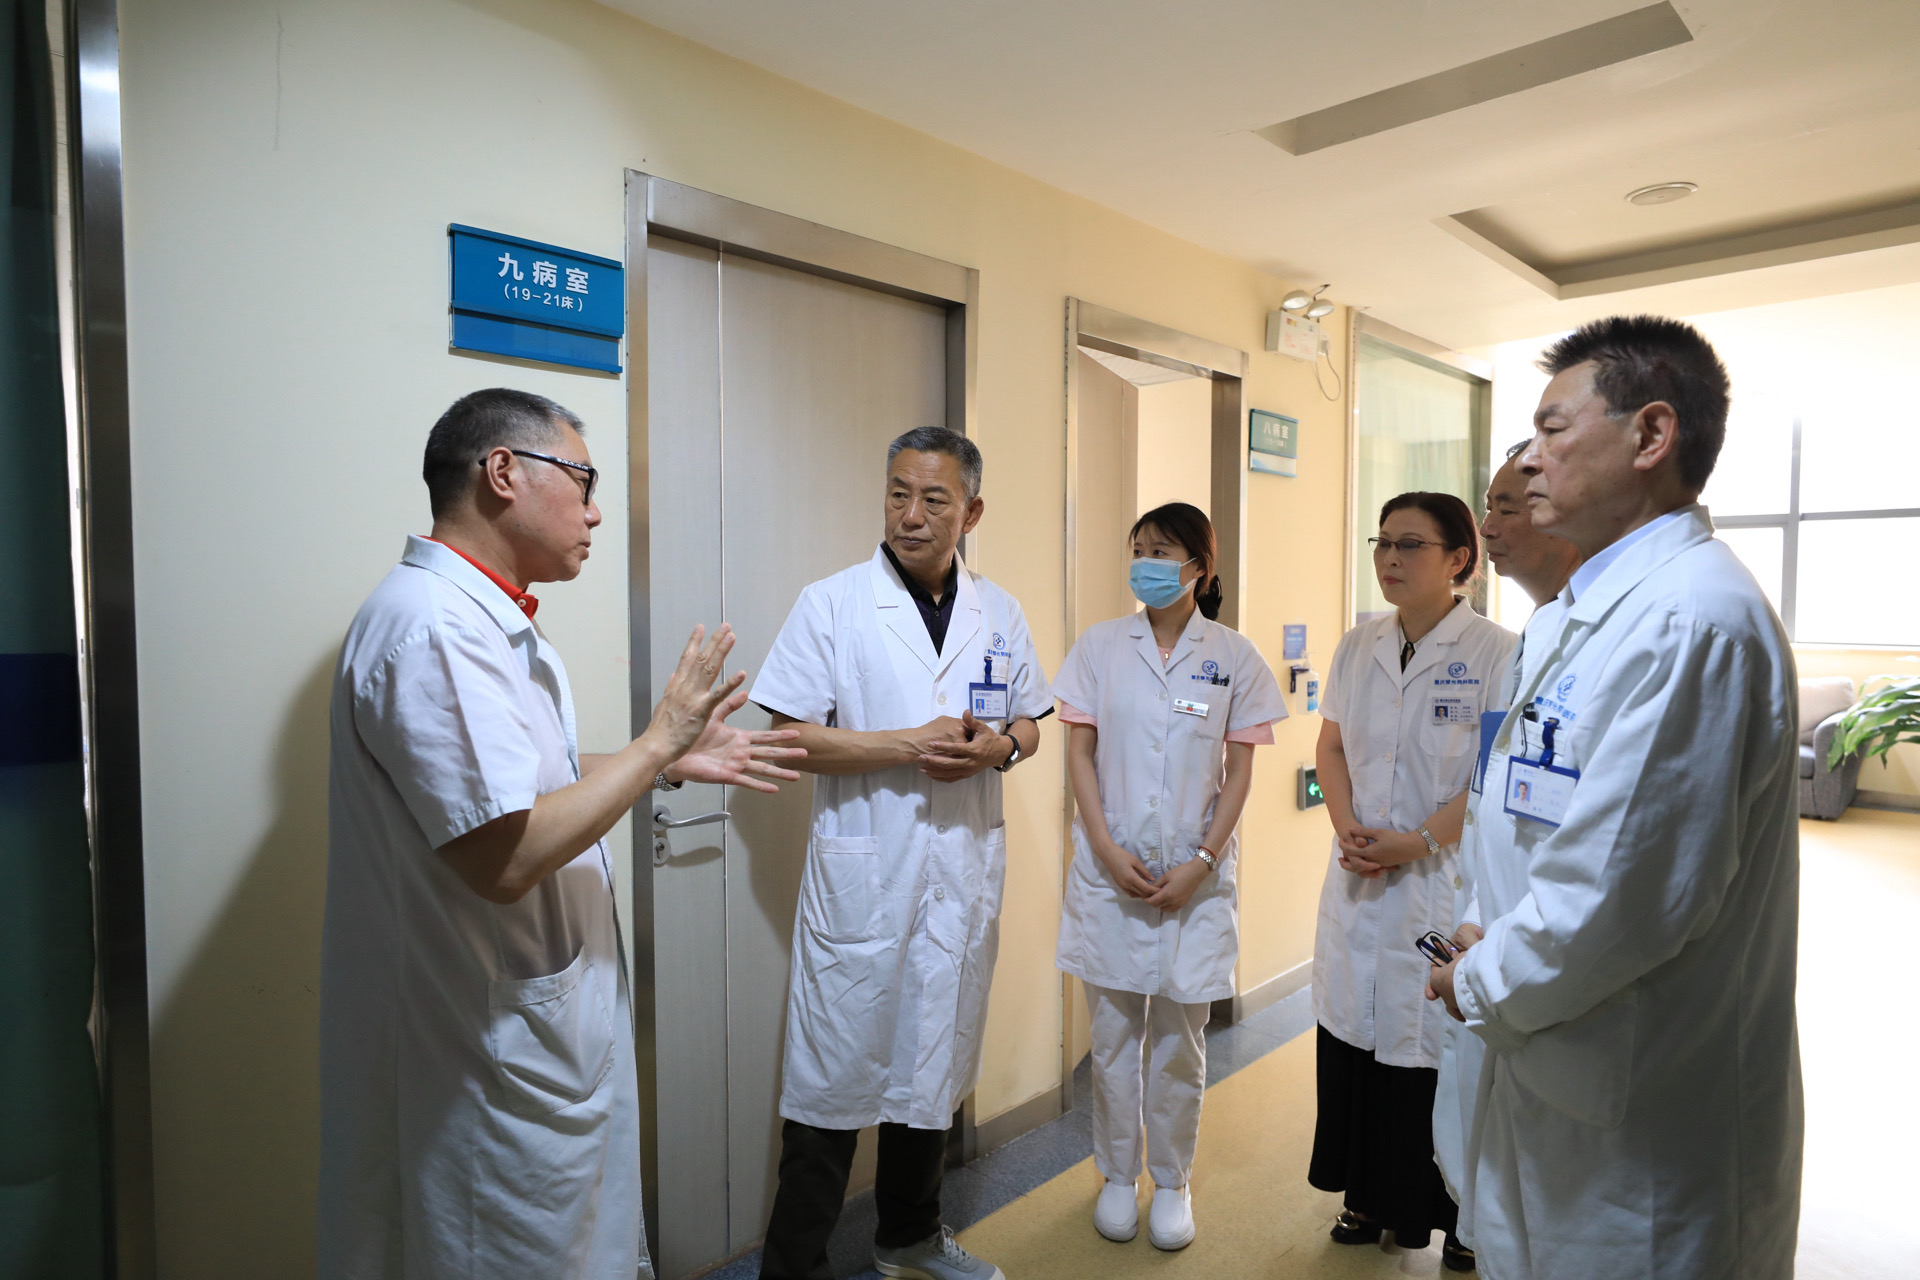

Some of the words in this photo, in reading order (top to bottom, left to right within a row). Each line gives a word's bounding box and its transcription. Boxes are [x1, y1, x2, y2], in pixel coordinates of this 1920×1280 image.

[498, 252, 589, 295] 九病室
[504, 283, 583, 312] (19-21床)
